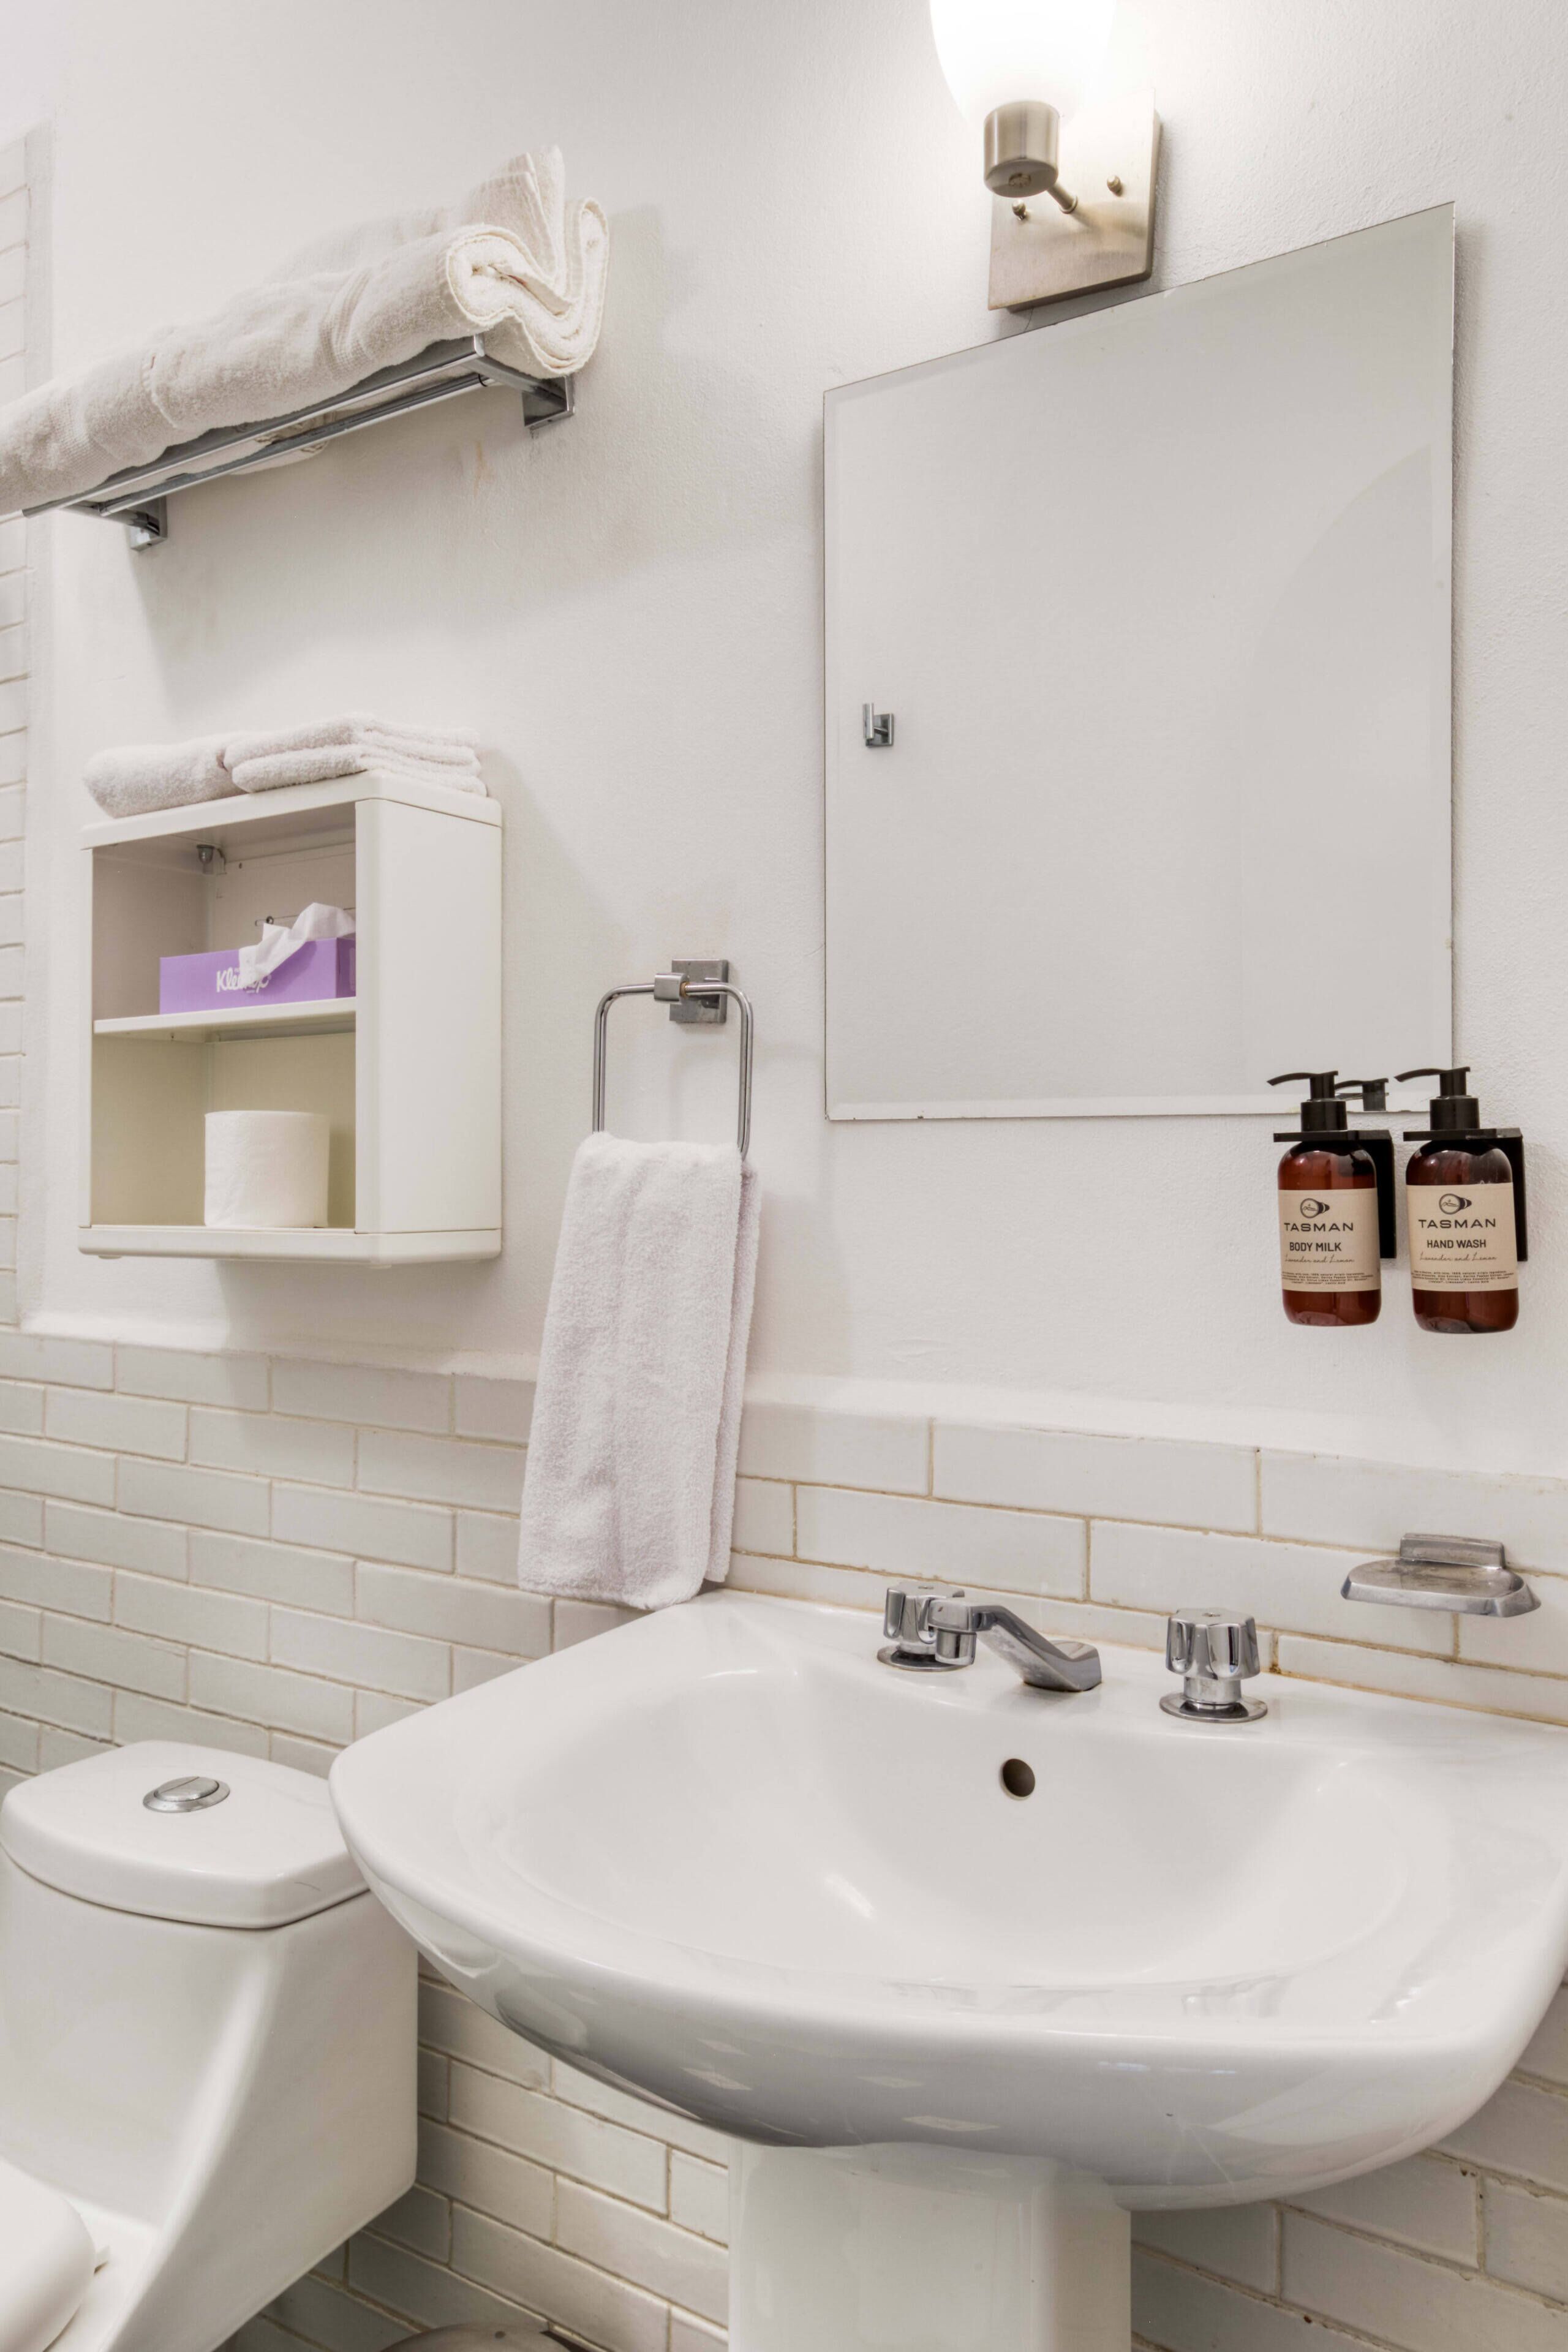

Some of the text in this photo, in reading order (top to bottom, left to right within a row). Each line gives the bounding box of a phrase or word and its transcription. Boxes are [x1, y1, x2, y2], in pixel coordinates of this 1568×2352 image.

[1284, 1223, 1354, 1232] TASMAN
[1418, 1218, 1496, 1228] TASMAN
[1289, 1242, 1342, 1251] BODY MILK
[1427, 1239, 1487, 1248] HAND WASH
